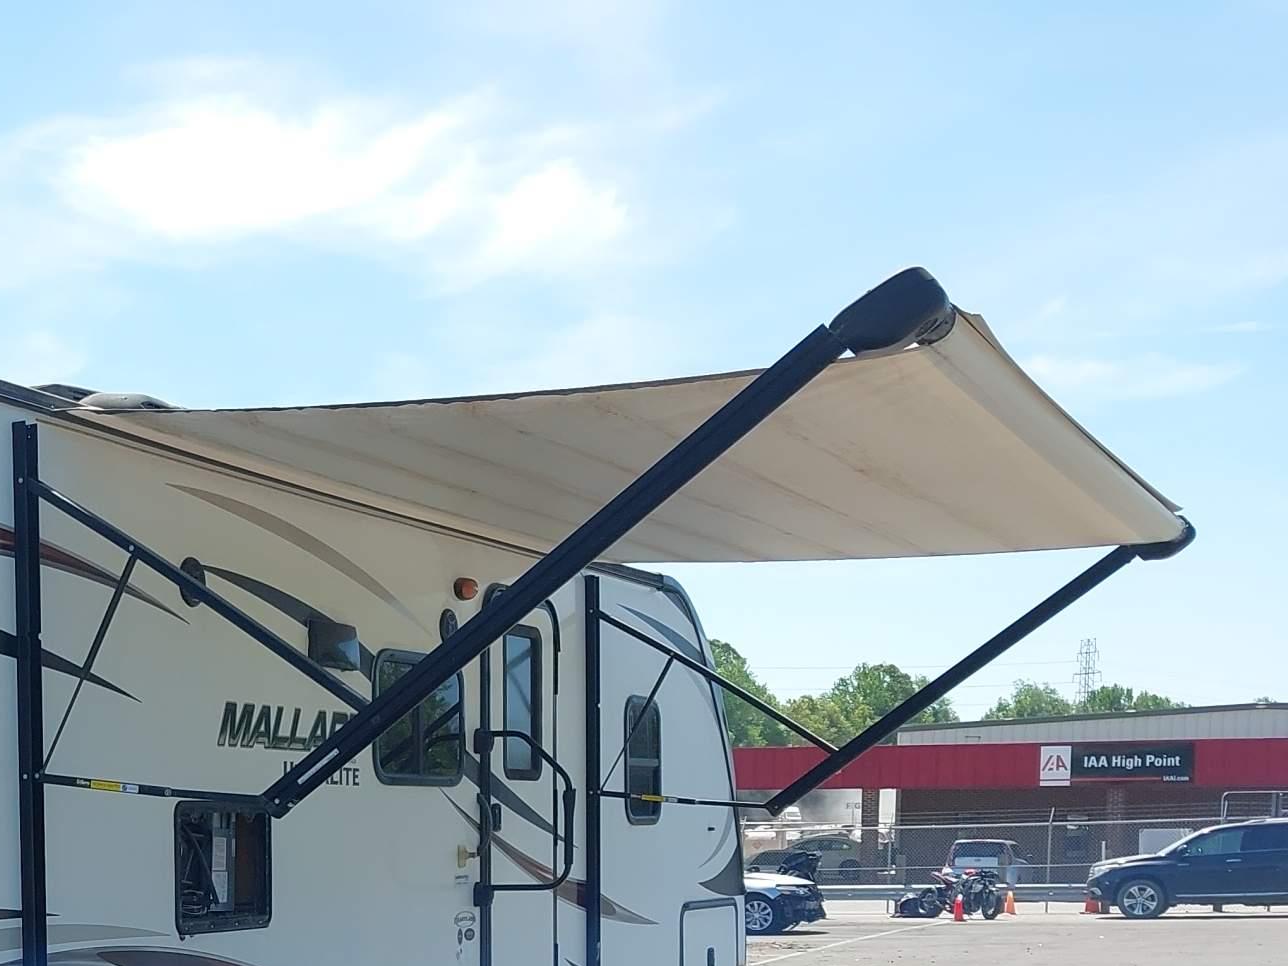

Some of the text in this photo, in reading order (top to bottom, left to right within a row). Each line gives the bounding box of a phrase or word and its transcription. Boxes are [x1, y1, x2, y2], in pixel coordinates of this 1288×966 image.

[217, 701, 359, 752] MALLAR
[1083, 754, 1181, 769] IAA High Point
